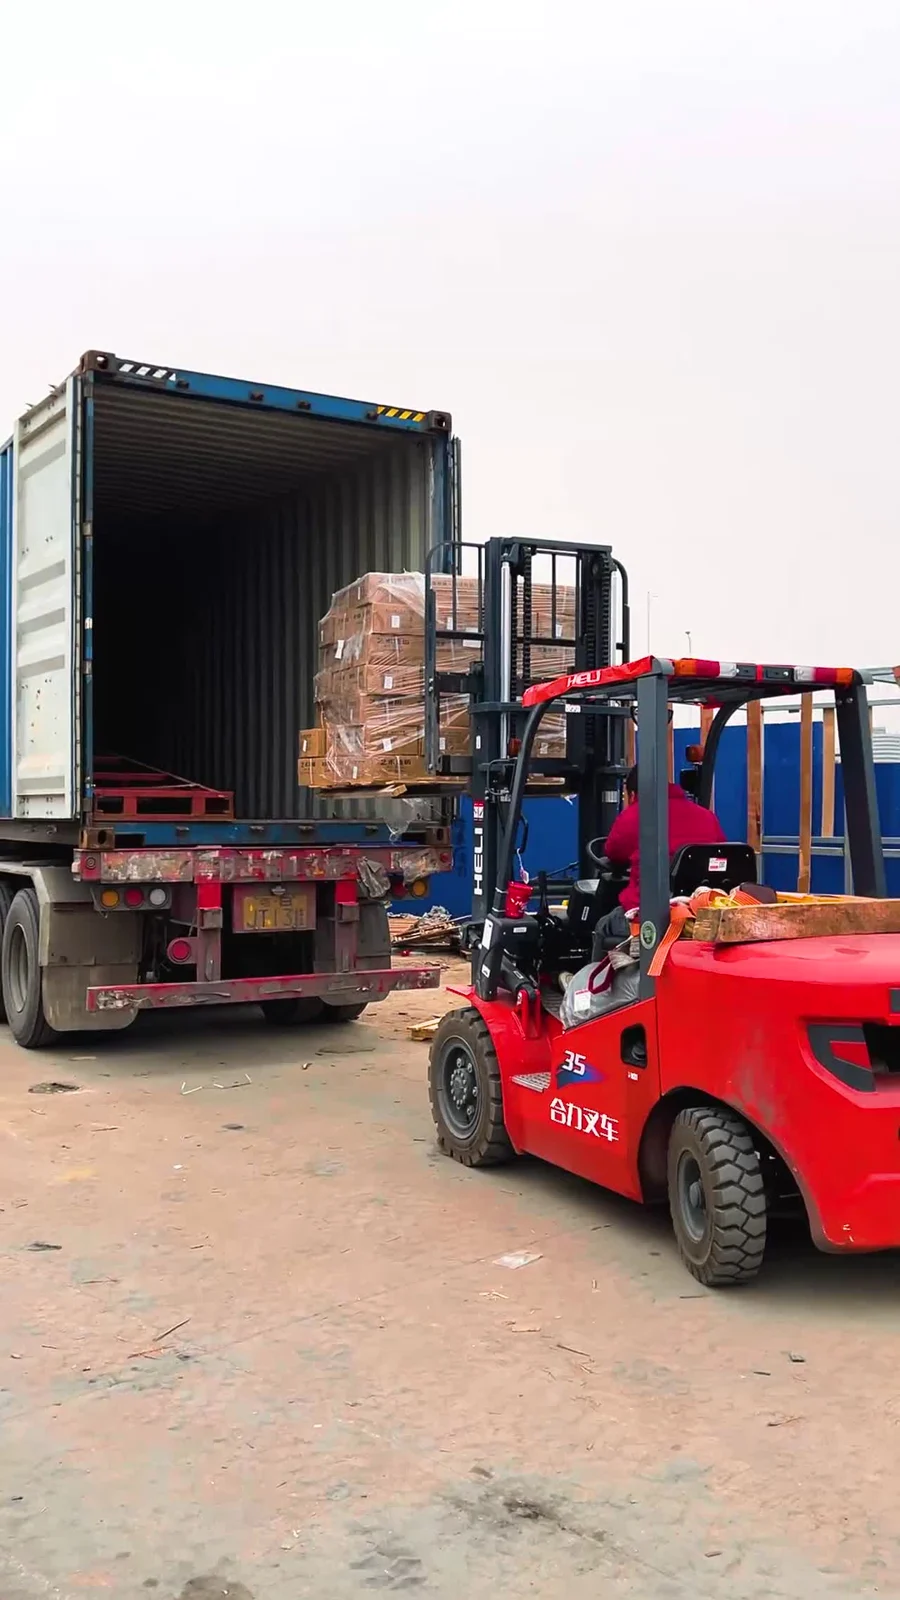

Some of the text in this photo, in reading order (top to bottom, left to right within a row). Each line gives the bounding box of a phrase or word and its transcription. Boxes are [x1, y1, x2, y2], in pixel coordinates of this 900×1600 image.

[567, 670, 601, 687] HELI
[473, 827, 483, 896] HELI
[562, 1050, 586, 1076] 35
[550, 1097, 619, 1142] 合力叉车
